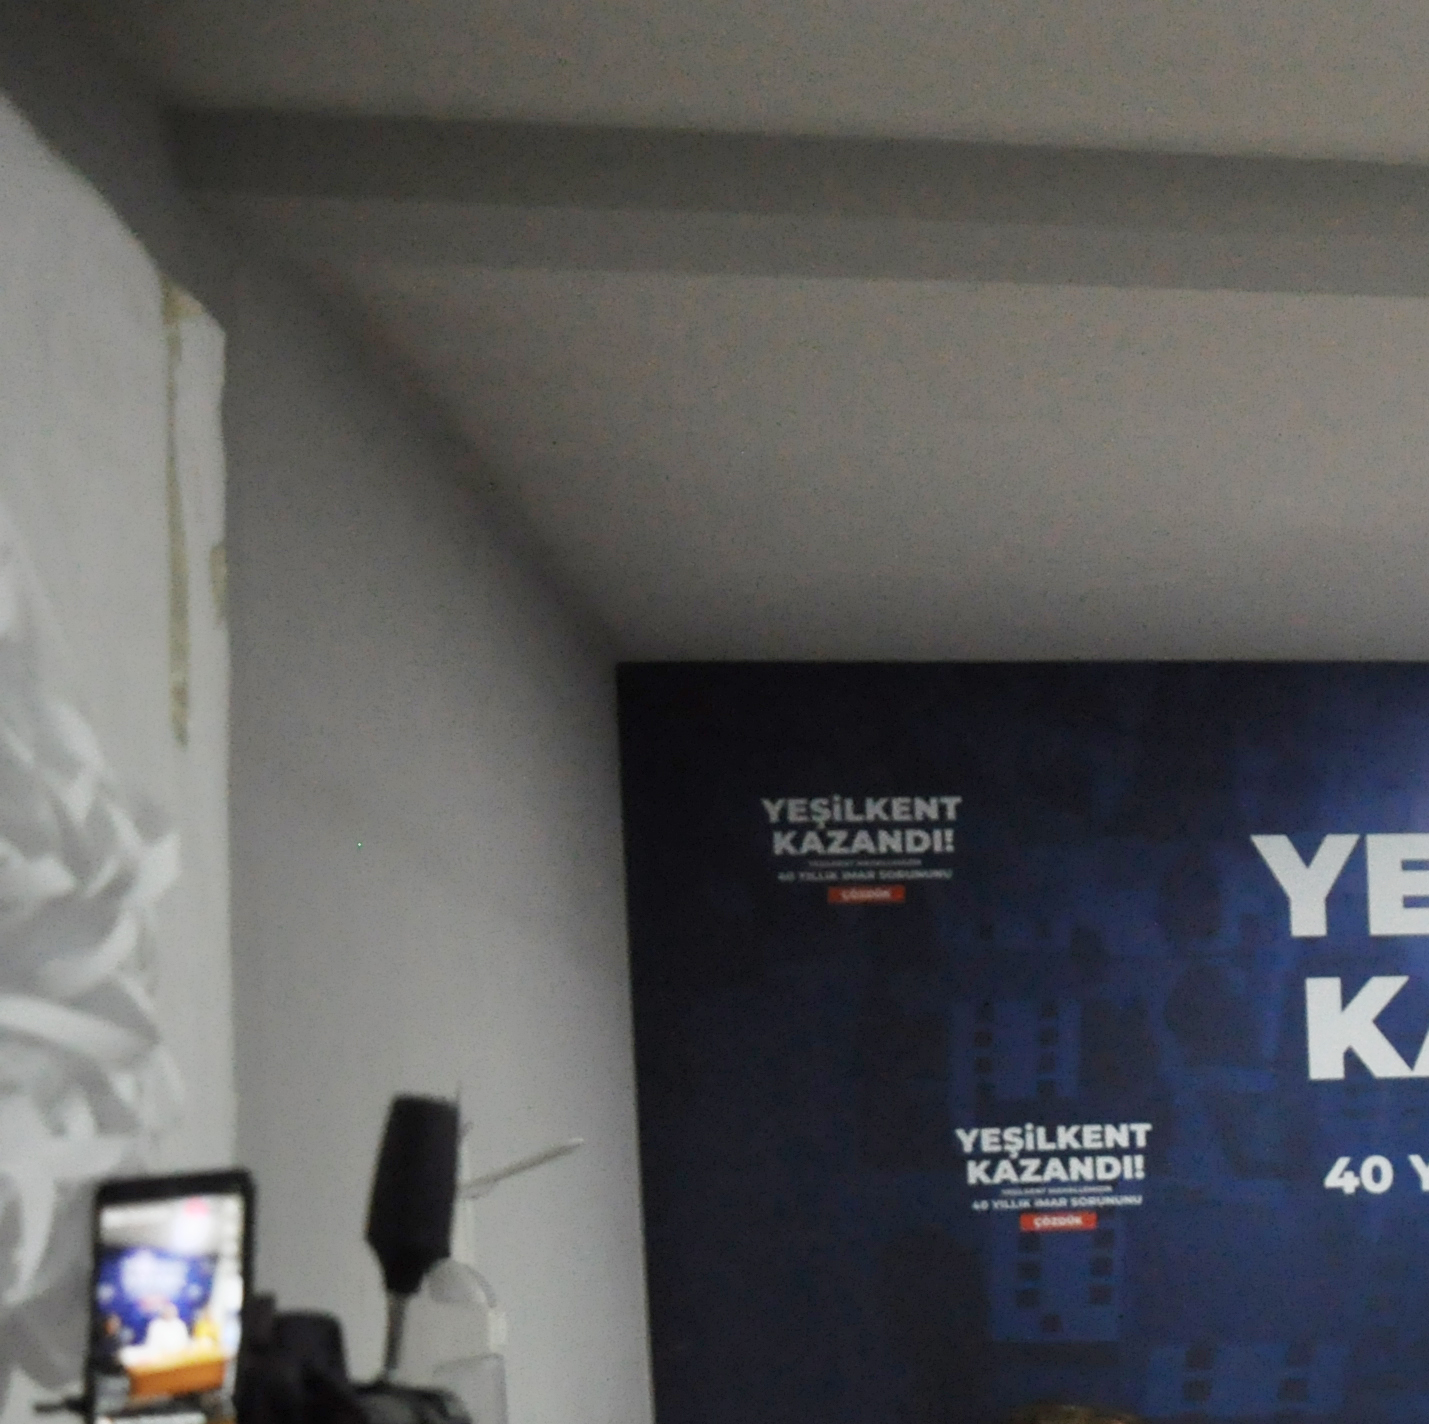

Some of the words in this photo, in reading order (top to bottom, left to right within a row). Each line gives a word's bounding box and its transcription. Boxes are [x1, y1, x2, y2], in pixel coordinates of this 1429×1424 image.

[772, 829, 955, 855] KAZANDI!
[966, 1155, 1146, 1185] KAZANDI!
[1323, 1155, 1395, 1195] 40
